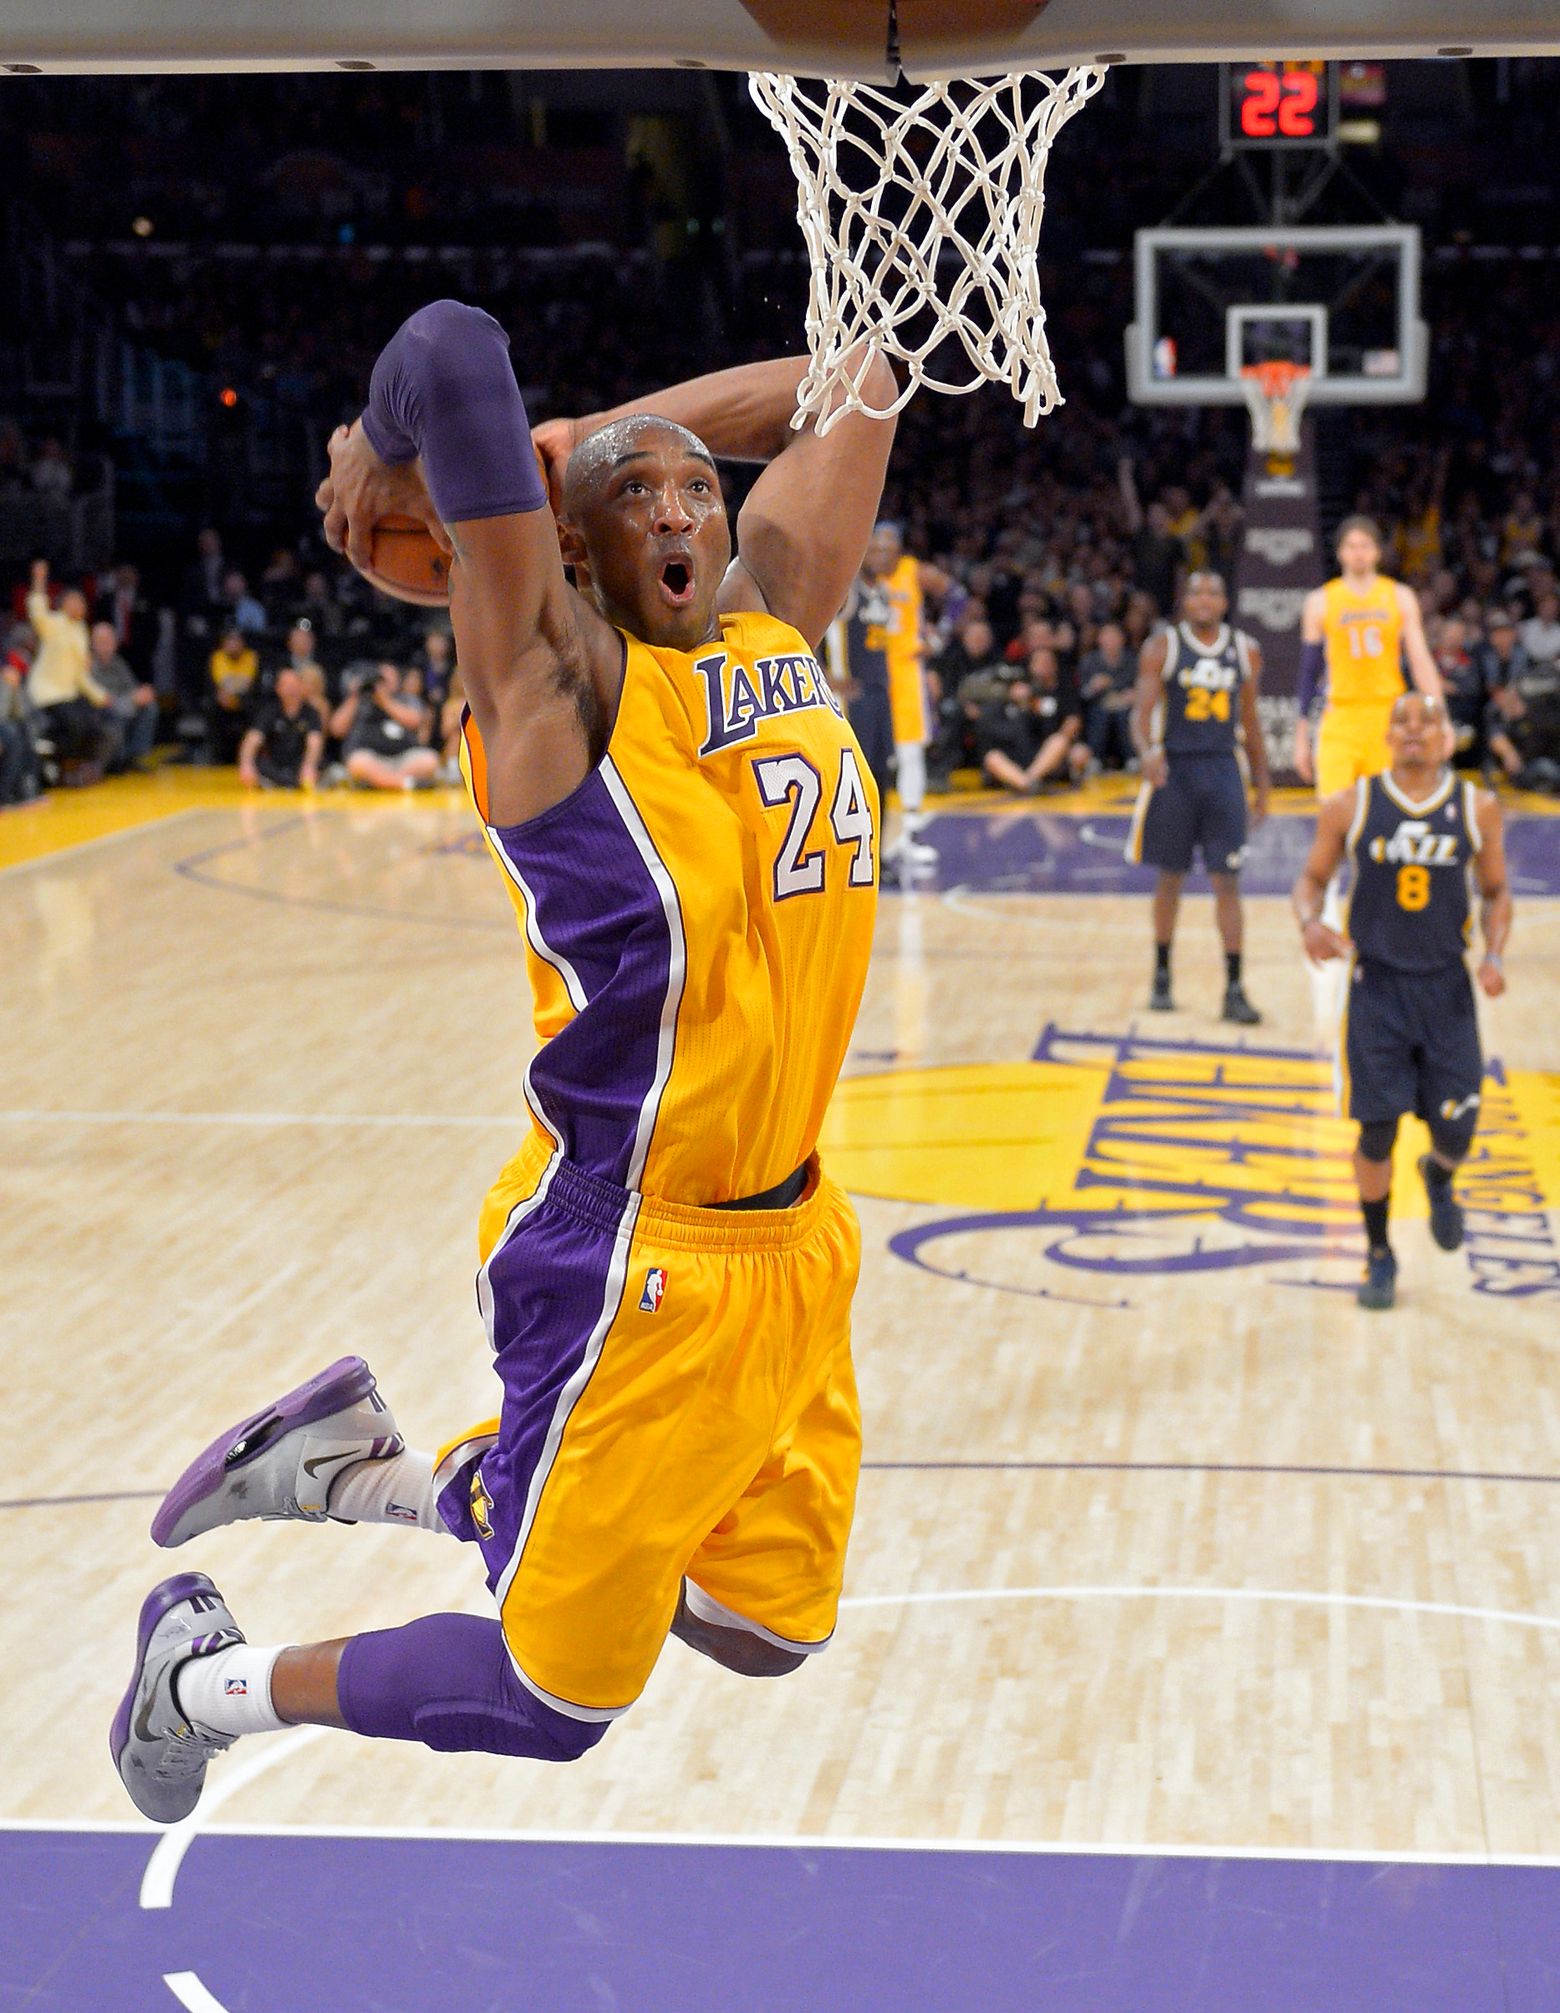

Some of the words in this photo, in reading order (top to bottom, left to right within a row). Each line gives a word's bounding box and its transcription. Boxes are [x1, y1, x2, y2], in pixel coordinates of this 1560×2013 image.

[1241, 71, 1317, 136] 22
[1184, 687, 1230, 722] 24
[751, 748, 873, 902] 24
[1396, 864, 1431, 911] 8
